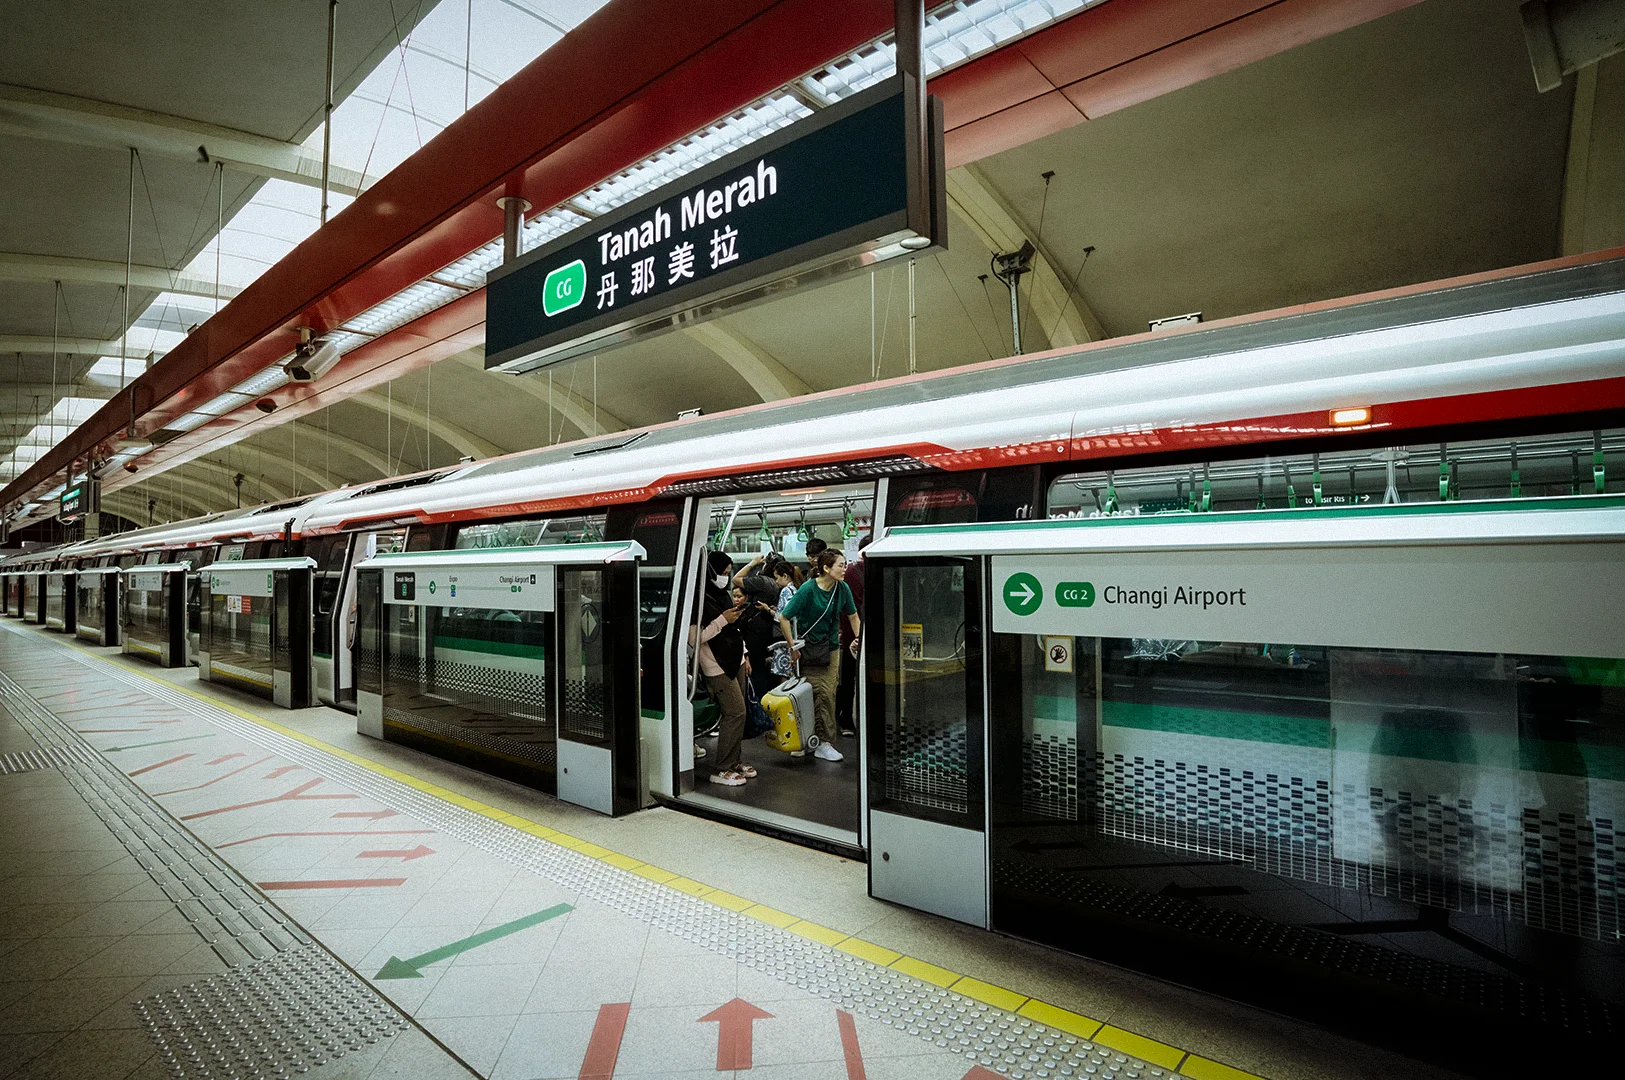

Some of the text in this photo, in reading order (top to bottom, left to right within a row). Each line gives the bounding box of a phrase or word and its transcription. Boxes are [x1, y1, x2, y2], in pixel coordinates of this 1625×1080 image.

[597, 159, 777, 265] Tanah Merah
[596, 225, 739, 310] 丹那美拉
[556, 277, 572, 299] CG
[499, 575, 530, 584] Changi Airport
[1063, 585, 1247, 610] CG 2 Changi Airport
